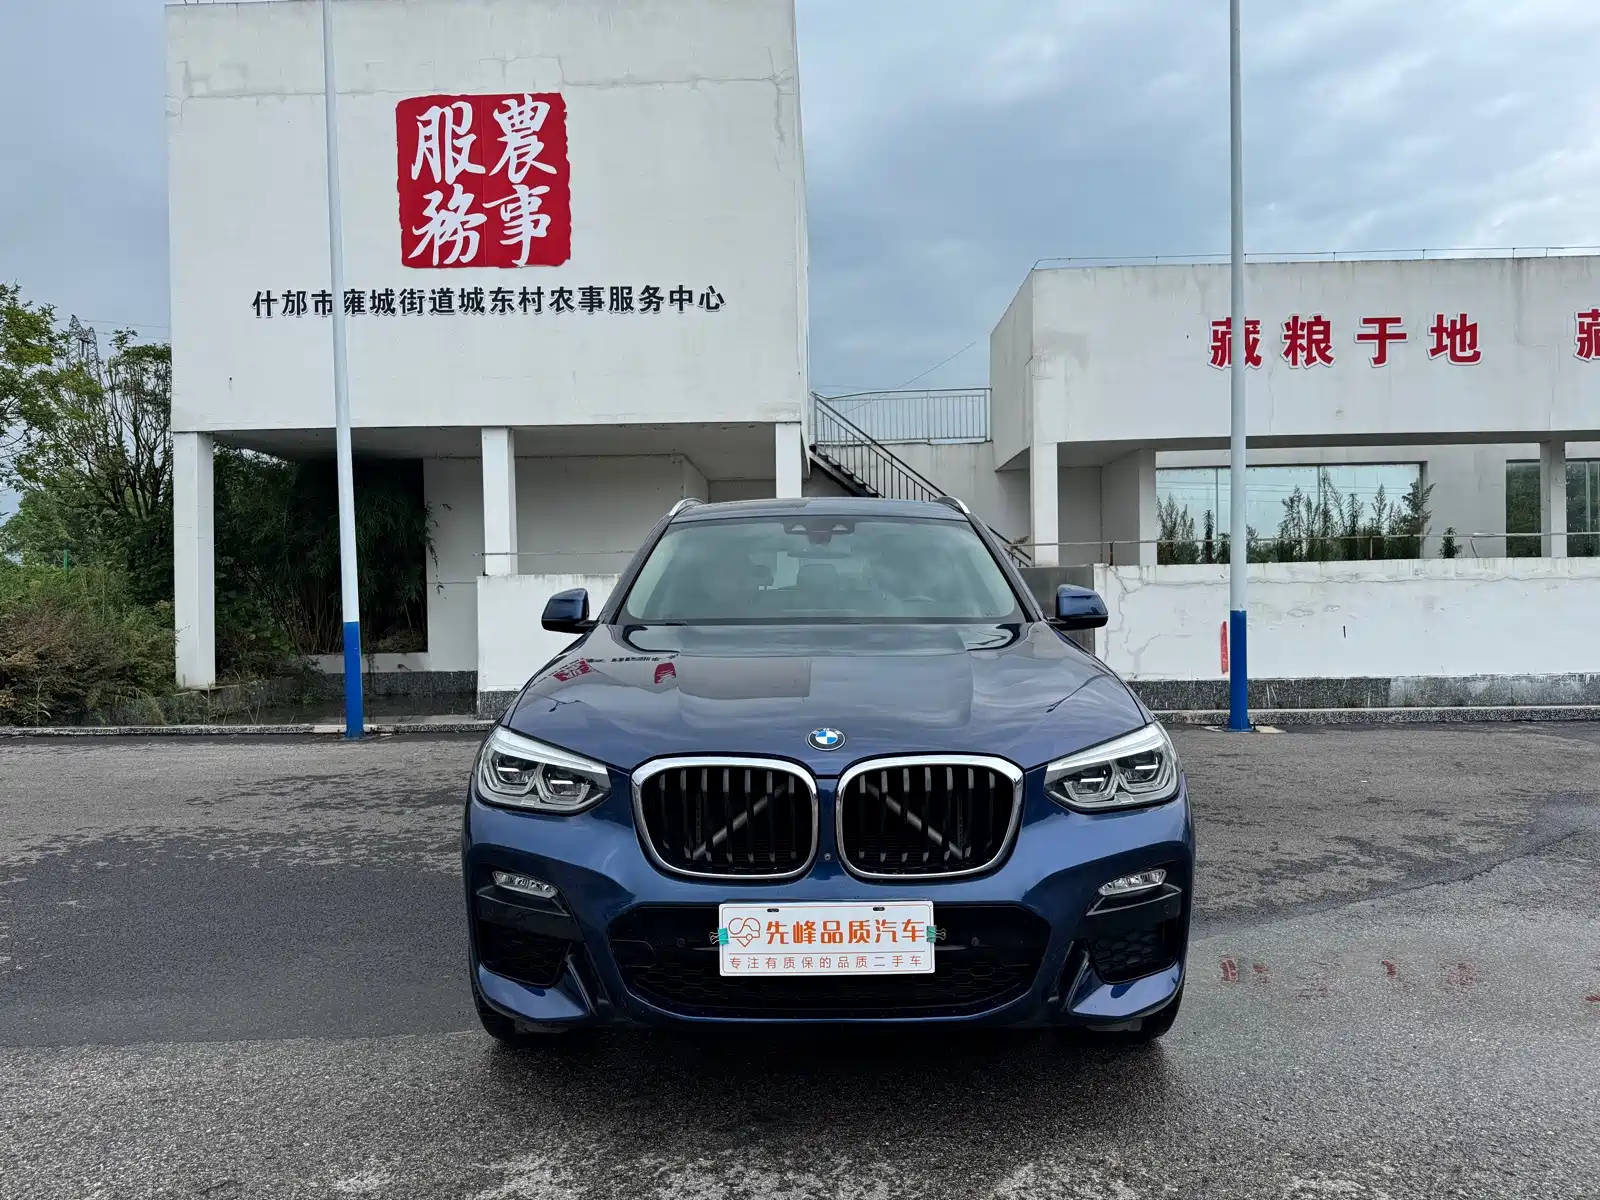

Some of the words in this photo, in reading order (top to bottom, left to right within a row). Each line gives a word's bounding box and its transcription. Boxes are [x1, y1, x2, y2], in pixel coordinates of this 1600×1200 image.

[1209, 313, 1483, 368] 藏粮于地
[765, 918, 926, 945] 先峰品质汽车
[729, 954, 922, 970] 专注有质保的品质二手车
